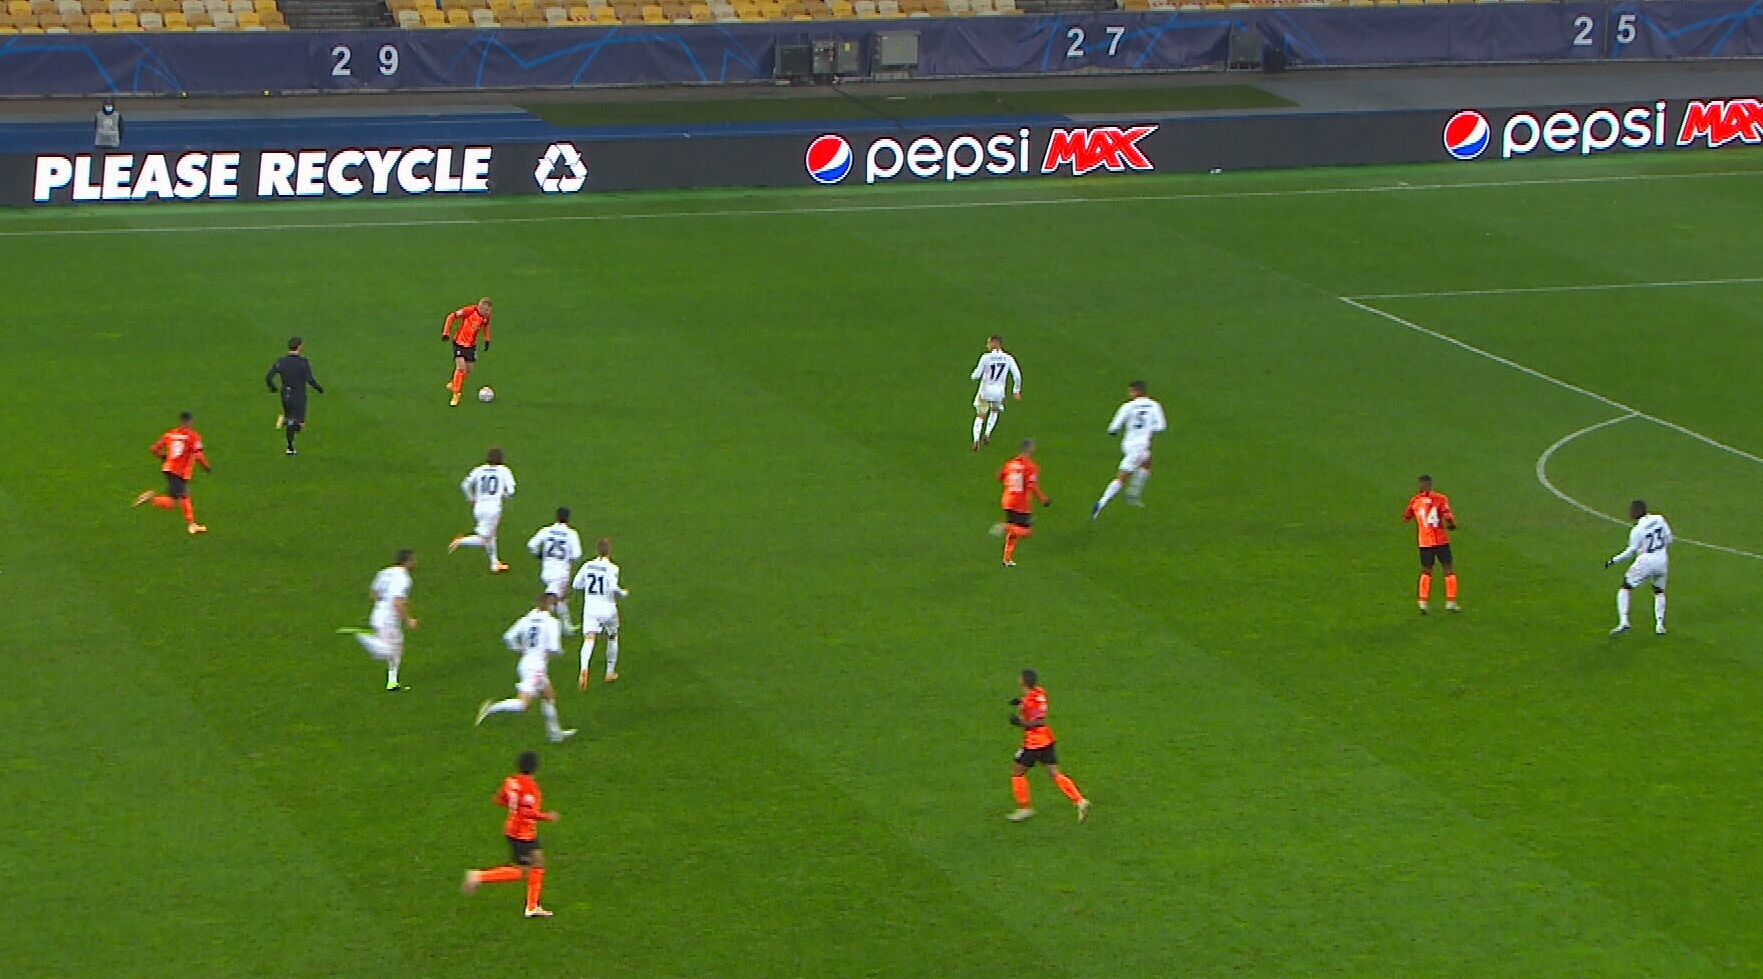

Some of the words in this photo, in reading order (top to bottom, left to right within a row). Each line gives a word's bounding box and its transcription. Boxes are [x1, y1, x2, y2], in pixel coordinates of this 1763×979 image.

[1502, 102, 1666, 159] pepsi
[866, 128, 1030, 184] pepsi
[1040, 124, 1159, 176] MAX
[33, 152, 240, 200] PLEASE
[257, 146, 492, 196] RECYCLE
[989, 362, 1007, 381] 17
[480, 474, 499, 495] 10
[1419, 506, 1440, 528] 14
[546, 536, 567, 560] 25
[1644, 526, 1666, 553] 23
[586, 572, 605, 595] 21
